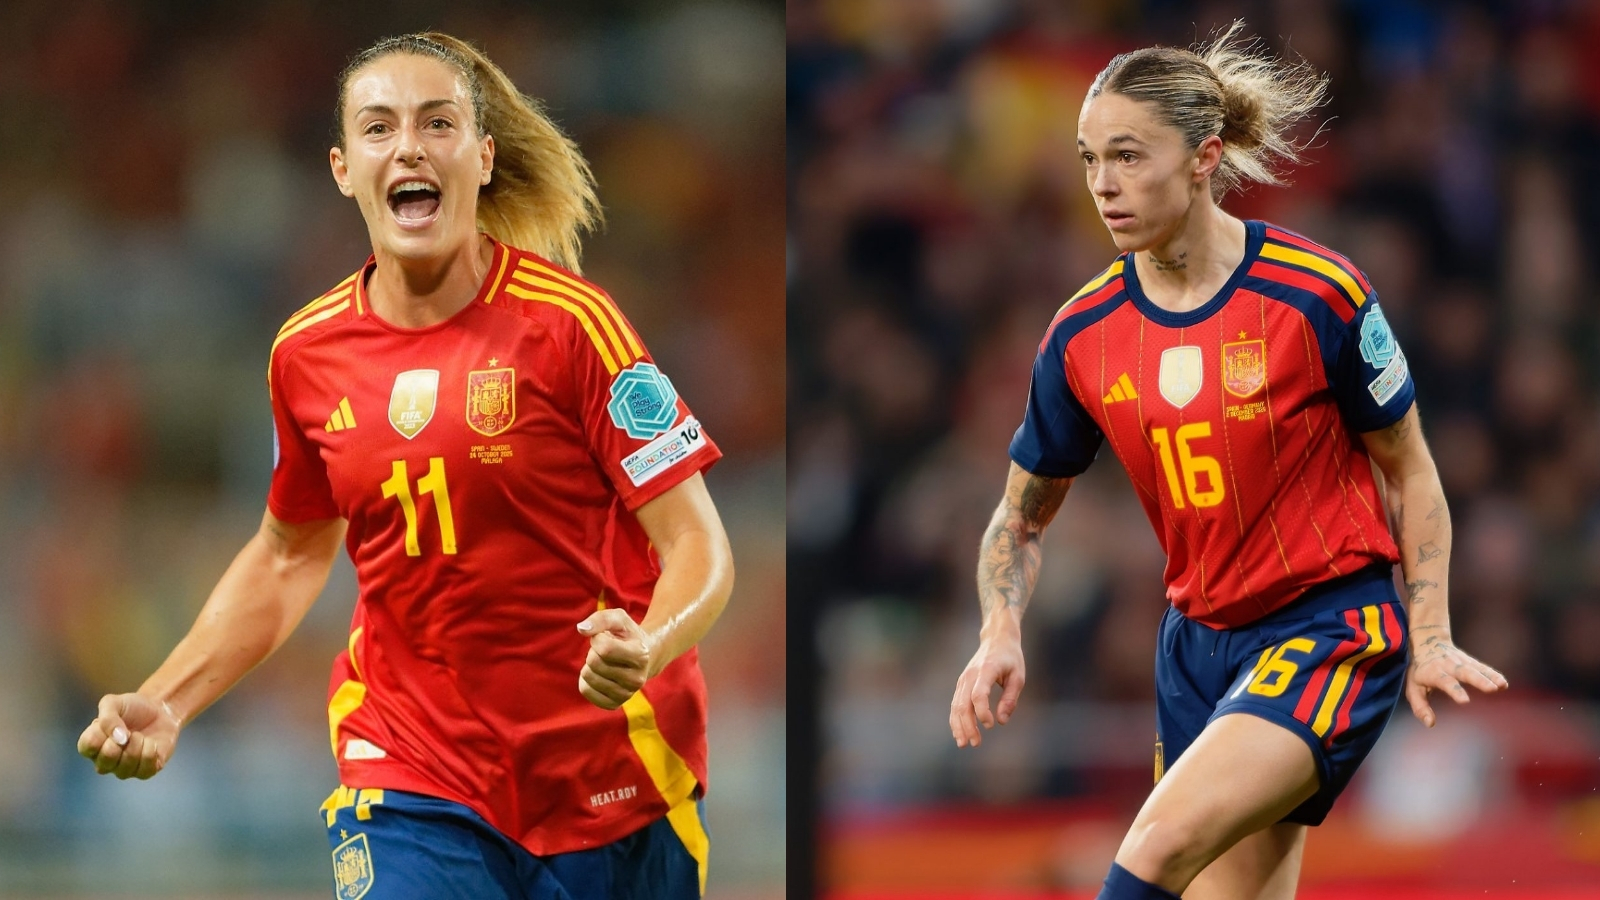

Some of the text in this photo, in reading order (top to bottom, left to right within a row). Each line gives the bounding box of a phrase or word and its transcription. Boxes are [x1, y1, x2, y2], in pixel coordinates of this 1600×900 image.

[632, 397, 651, 410] play
[401, 411, 421, 421] FIFA
[624, 455, 639, 467] UEFA
[629, 440, 683, 476] FOUNDATION
[1152, 421, 1225, 509] 16
[381, 457, 457, 556] 11
[590, 785, 637, 807] HEAT.RDY
